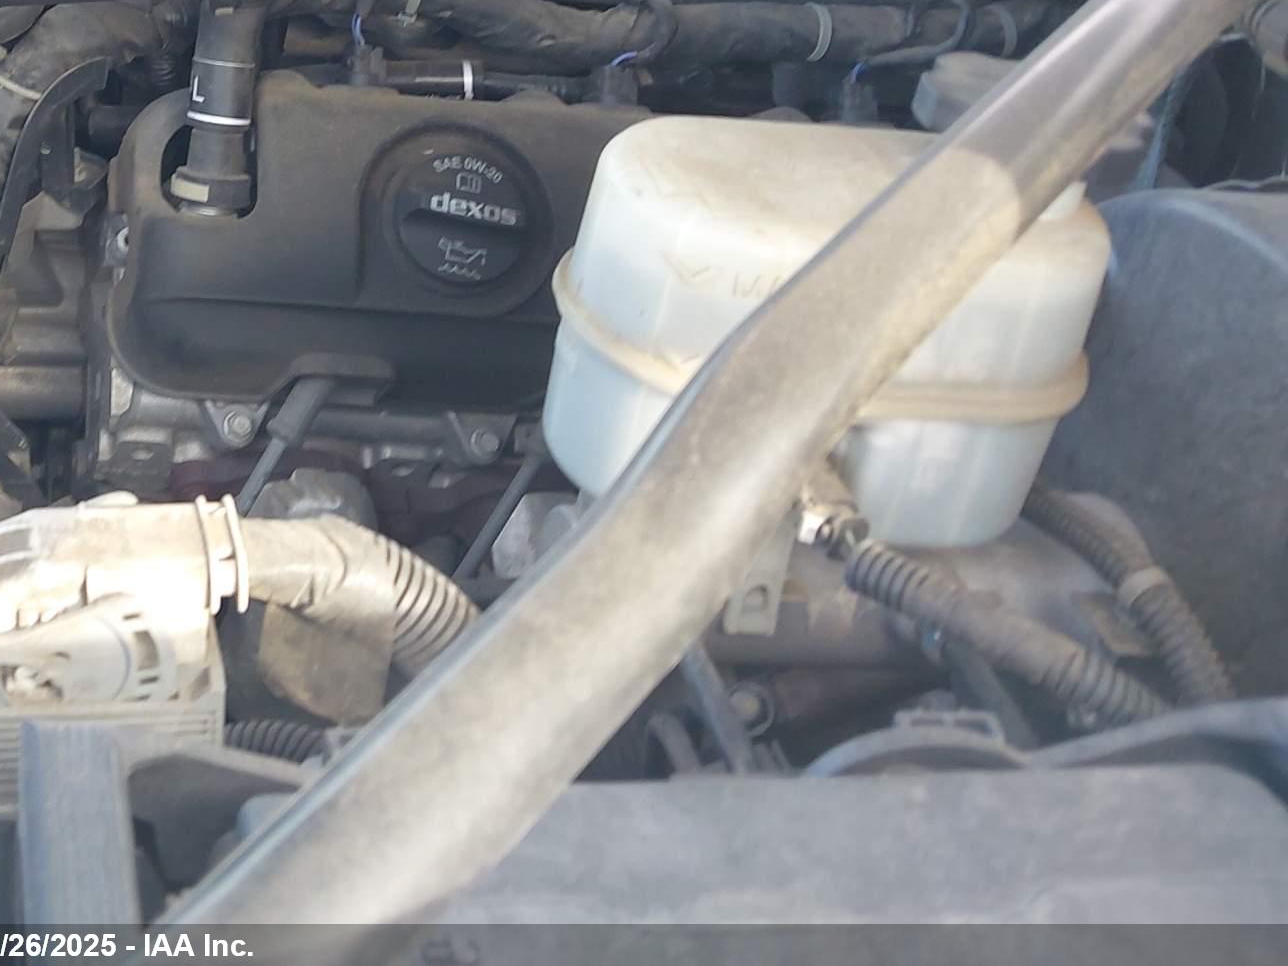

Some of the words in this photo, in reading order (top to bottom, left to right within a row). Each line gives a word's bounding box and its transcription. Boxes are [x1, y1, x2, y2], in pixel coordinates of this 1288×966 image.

[191, 74, 206, 103] L
[432, 155, 462, 173] SAE
[463, 156, 504, 184] 0W-20
[430, 191, 517, 226] dexos
